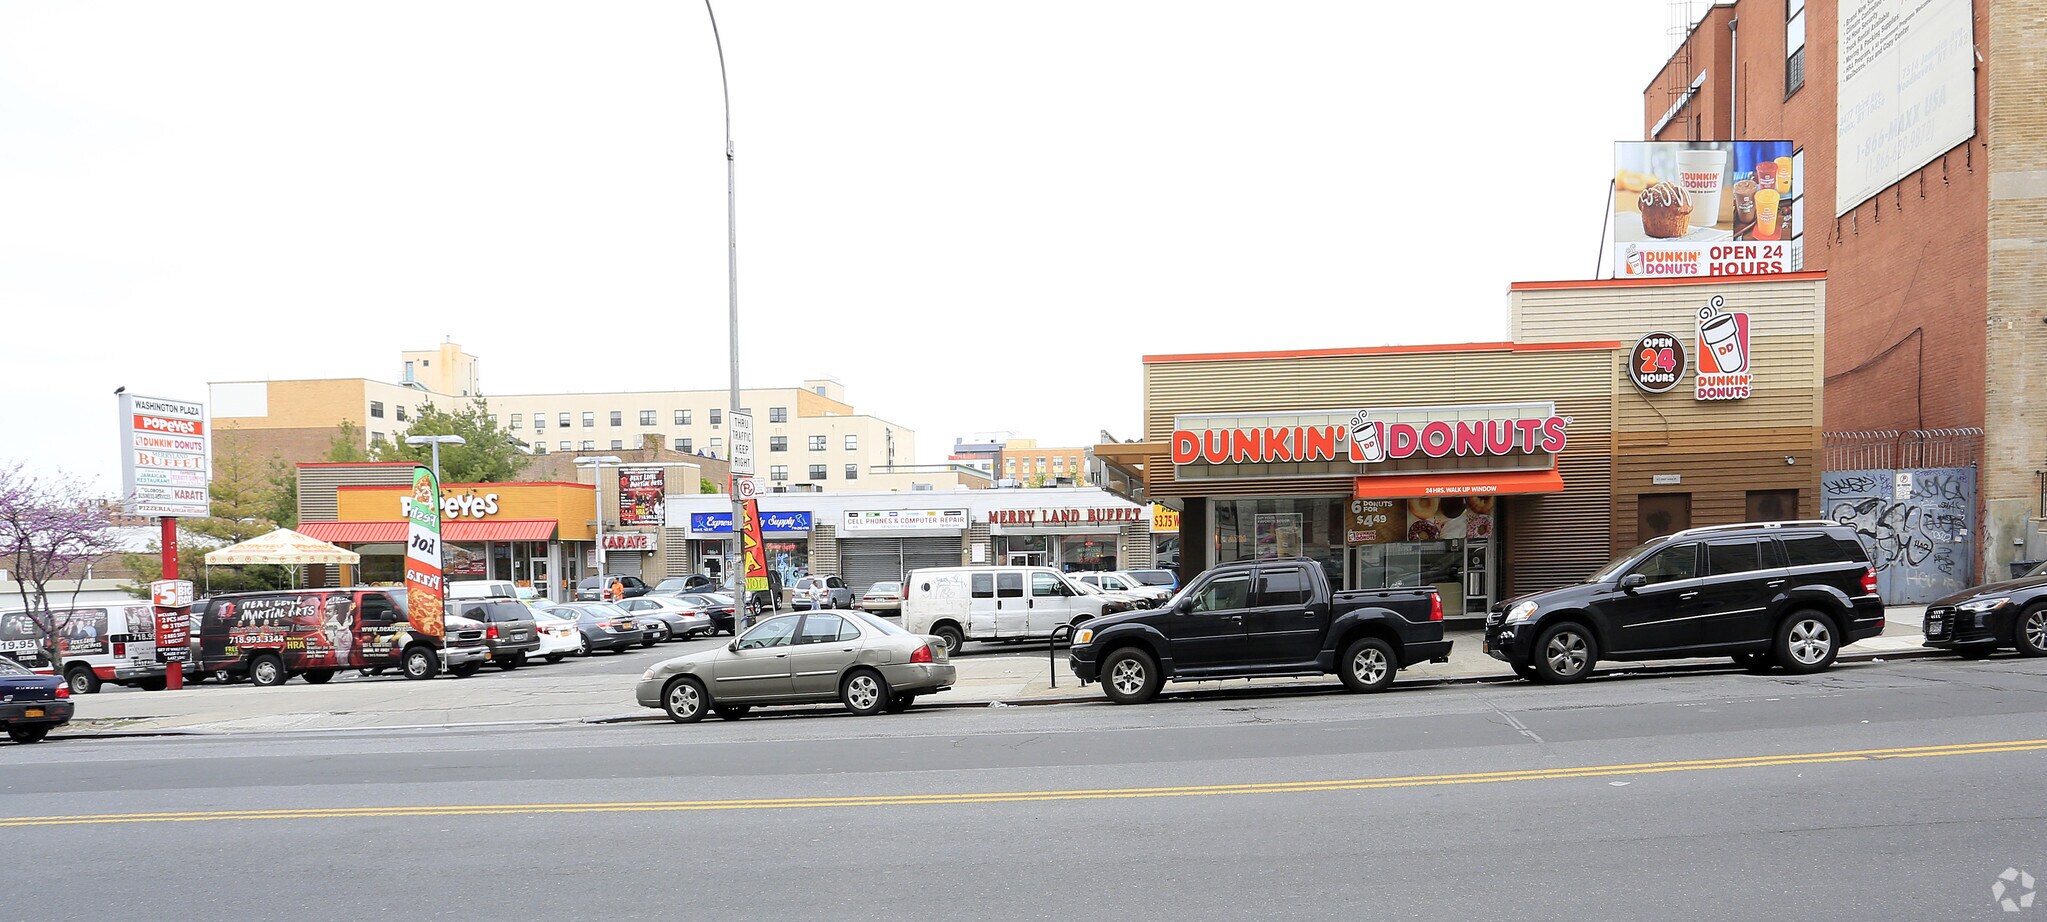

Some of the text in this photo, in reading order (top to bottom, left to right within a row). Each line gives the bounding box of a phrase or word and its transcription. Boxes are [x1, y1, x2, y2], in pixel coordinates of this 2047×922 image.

[1861, 9, 1877, 30] Security
[1870, 9, 1889, 32] Available
[1881, 11, 1899, 33] Supplies
[1924, 82, 1946, 118] USA
[1685, 172, 1719, 180] DUNKIN'
[1685, 181, 1717, 189] DONUTS
[1646, 251, 1700, 262] DUNKIN'
[1710, 245, 1783, 260] OPEN 24
[1646, 263, 1698, 275] DONUTS
[1710, 261, 1783, 278] HOURS
[1643, 337, 1673, 348] OPEN
[1640, 347, 1677, 374] 24
[1640, 373, 1675, 385] HOURS
[1697, 374, 1752, 388] DUNKIN'
[1697, 387, 1749, 399] DONUTS
[135, 400, 200, 416] WASHINGTON PLAZA
[734, 417, 749, 429] THRU
[732, 430, 752, 442] TRAFFIC
[1171, 415, 1567, 465] DUNKIN' DONUTS
[143, 437, 202, 451] DUNKIN' DONUTS
[735, 444, 750, 455] KEEP
[138, 452, 202, 470] BUFFET
[734, 456, 751, 468] RIGHT
[174, 489, 204, 501] KARATE
[1471, 485, 1497, 493] WINDOW
[1350, 500, 1393, 515] 6 DONUTS
[1363, 506, 1379, 514] FOR
[767, 513, 797, 531] Supply
[940, 516, 965, 524] REPAIR
[988, 508, 1142, 525] MERRY LAND BUFFET
[178, 586, 193, 597] BIG
[241, 605, 314, 621] MARTIAL ARTS
[229, 635, 285, 644] 718.993.3344
[287, 641, 306, 650] HRA
